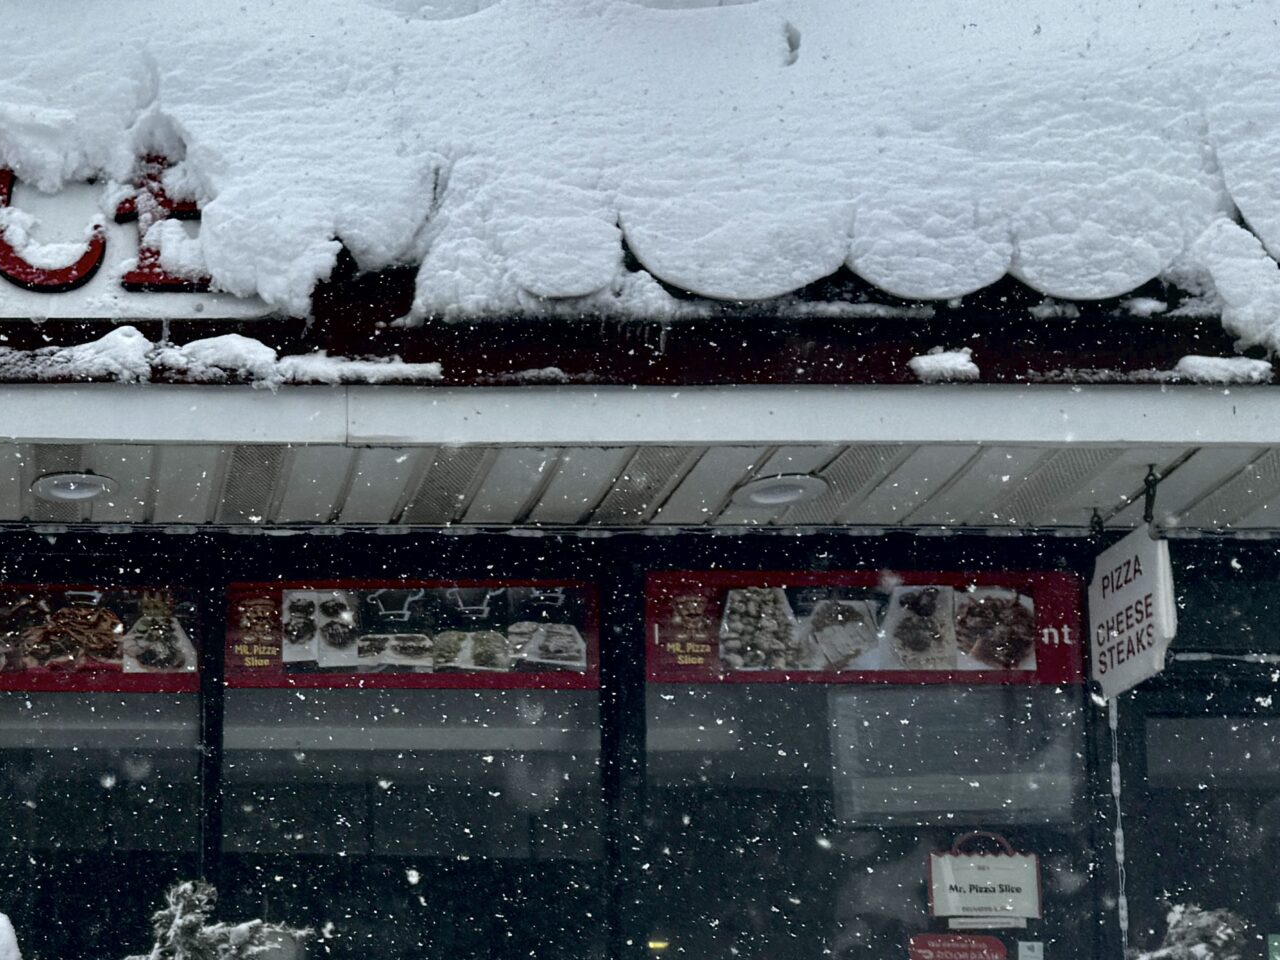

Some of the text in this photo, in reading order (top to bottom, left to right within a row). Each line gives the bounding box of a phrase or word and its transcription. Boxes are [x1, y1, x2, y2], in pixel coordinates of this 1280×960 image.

[1101, 554, 1143, 599] PIZZA
[1096, 593, 1154, 648] CHEESE
[1098, 623, 1155, 674] STEAKS
[949, 883, 1022, 894] Mr. Pizza Slice
